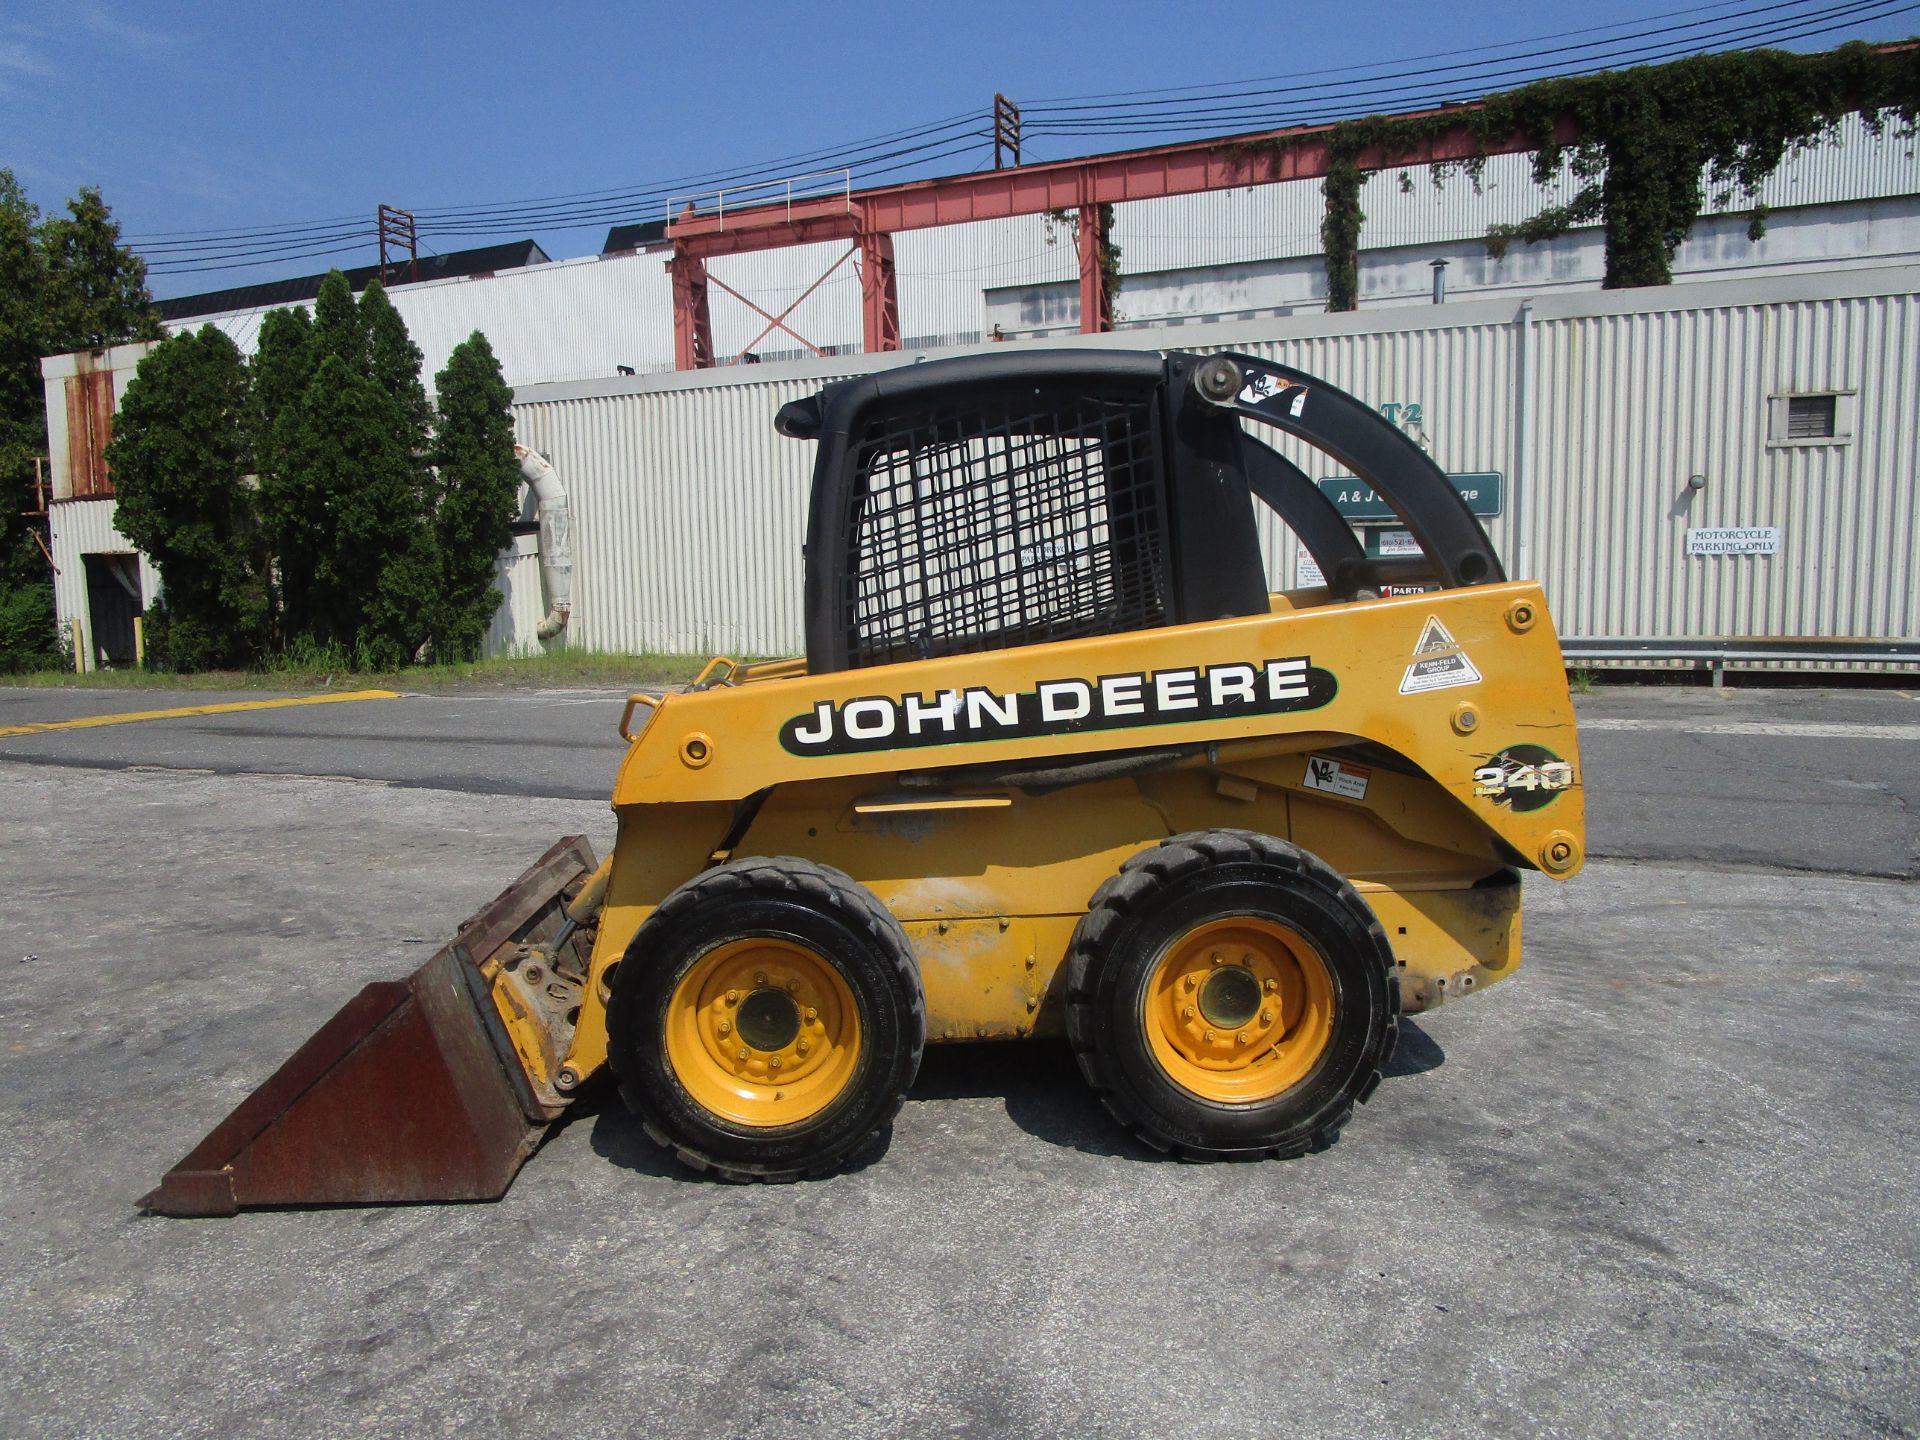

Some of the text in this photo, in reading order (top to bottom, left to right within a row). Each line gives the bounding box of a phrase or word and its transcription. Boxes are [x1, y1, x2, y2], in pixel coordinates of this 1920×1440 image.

[1338, 491, 1348, 502] A
[1351, 491, 1361, 502] &
[1365, 490, 1374, 502] J
[1695, 531, 1771, 540] MOTORCYCLE
[1692, 541, 1775, 551] PARKING ONLY
[1393, 587, 1424, 595] PARTS
[1420, 659, 1456, 669] KENN-FELD
[1426, 665, 1450, 674] GROUP
[795, 660, 1309, 744] JOHN DEERE
